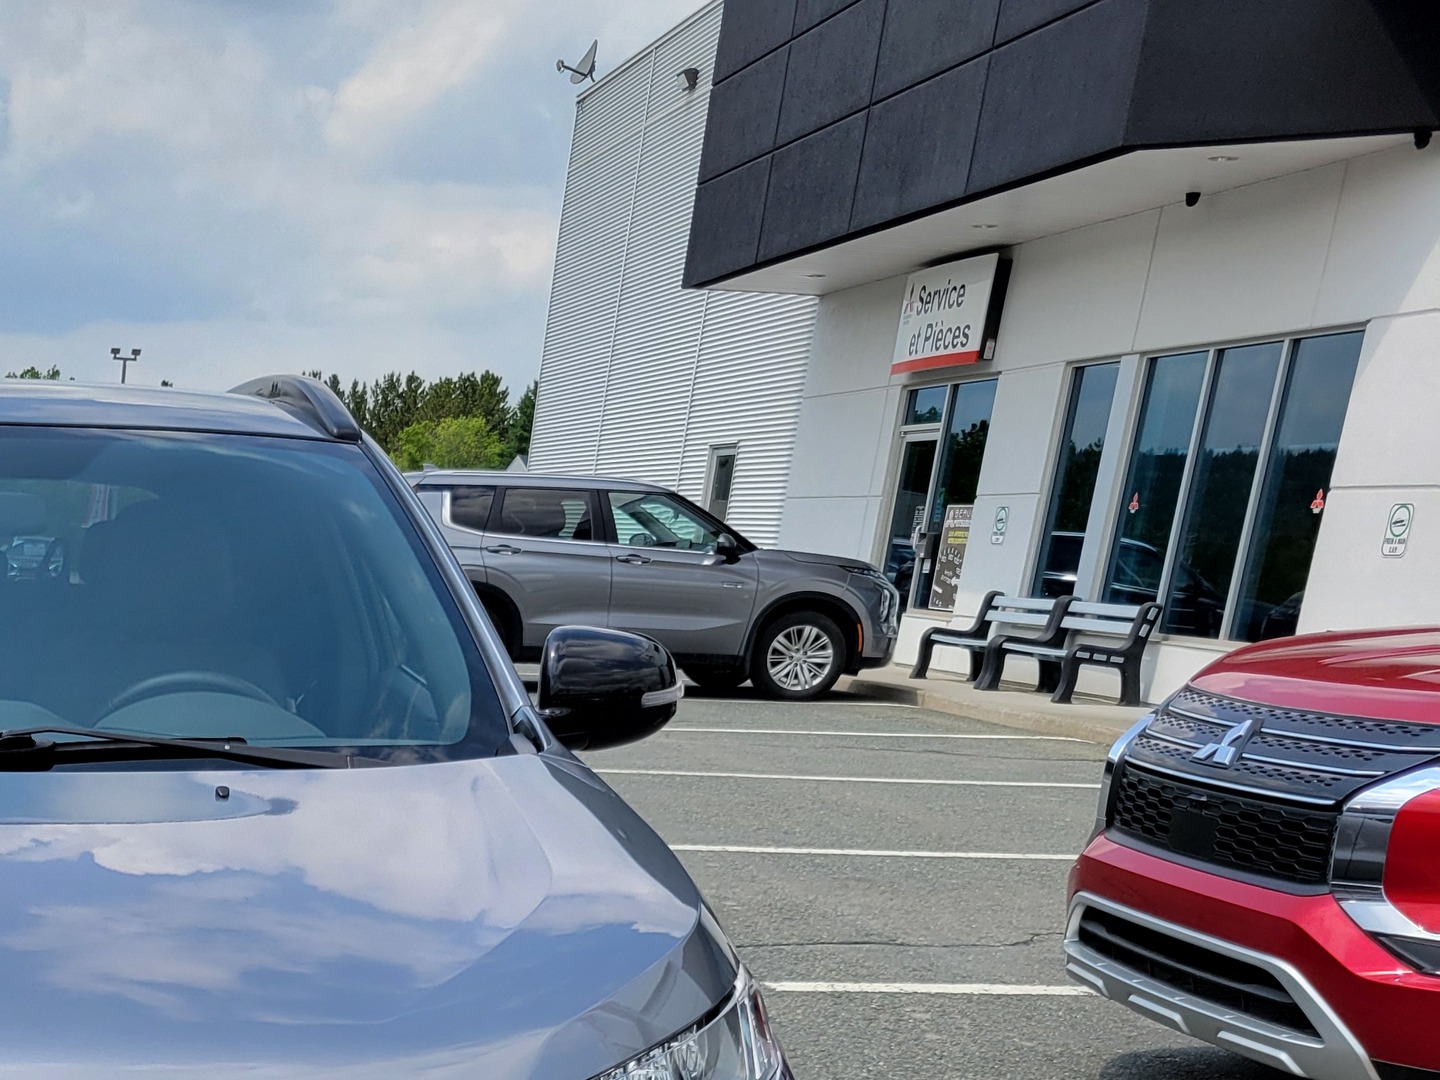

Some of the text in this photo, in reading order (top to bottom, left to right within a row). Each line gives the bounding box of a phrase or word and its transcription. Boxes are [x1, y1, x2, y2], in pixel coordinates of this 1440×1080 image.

[916, 278, 966, 317] Service
[908, 320, 971, 357] et Pièces
